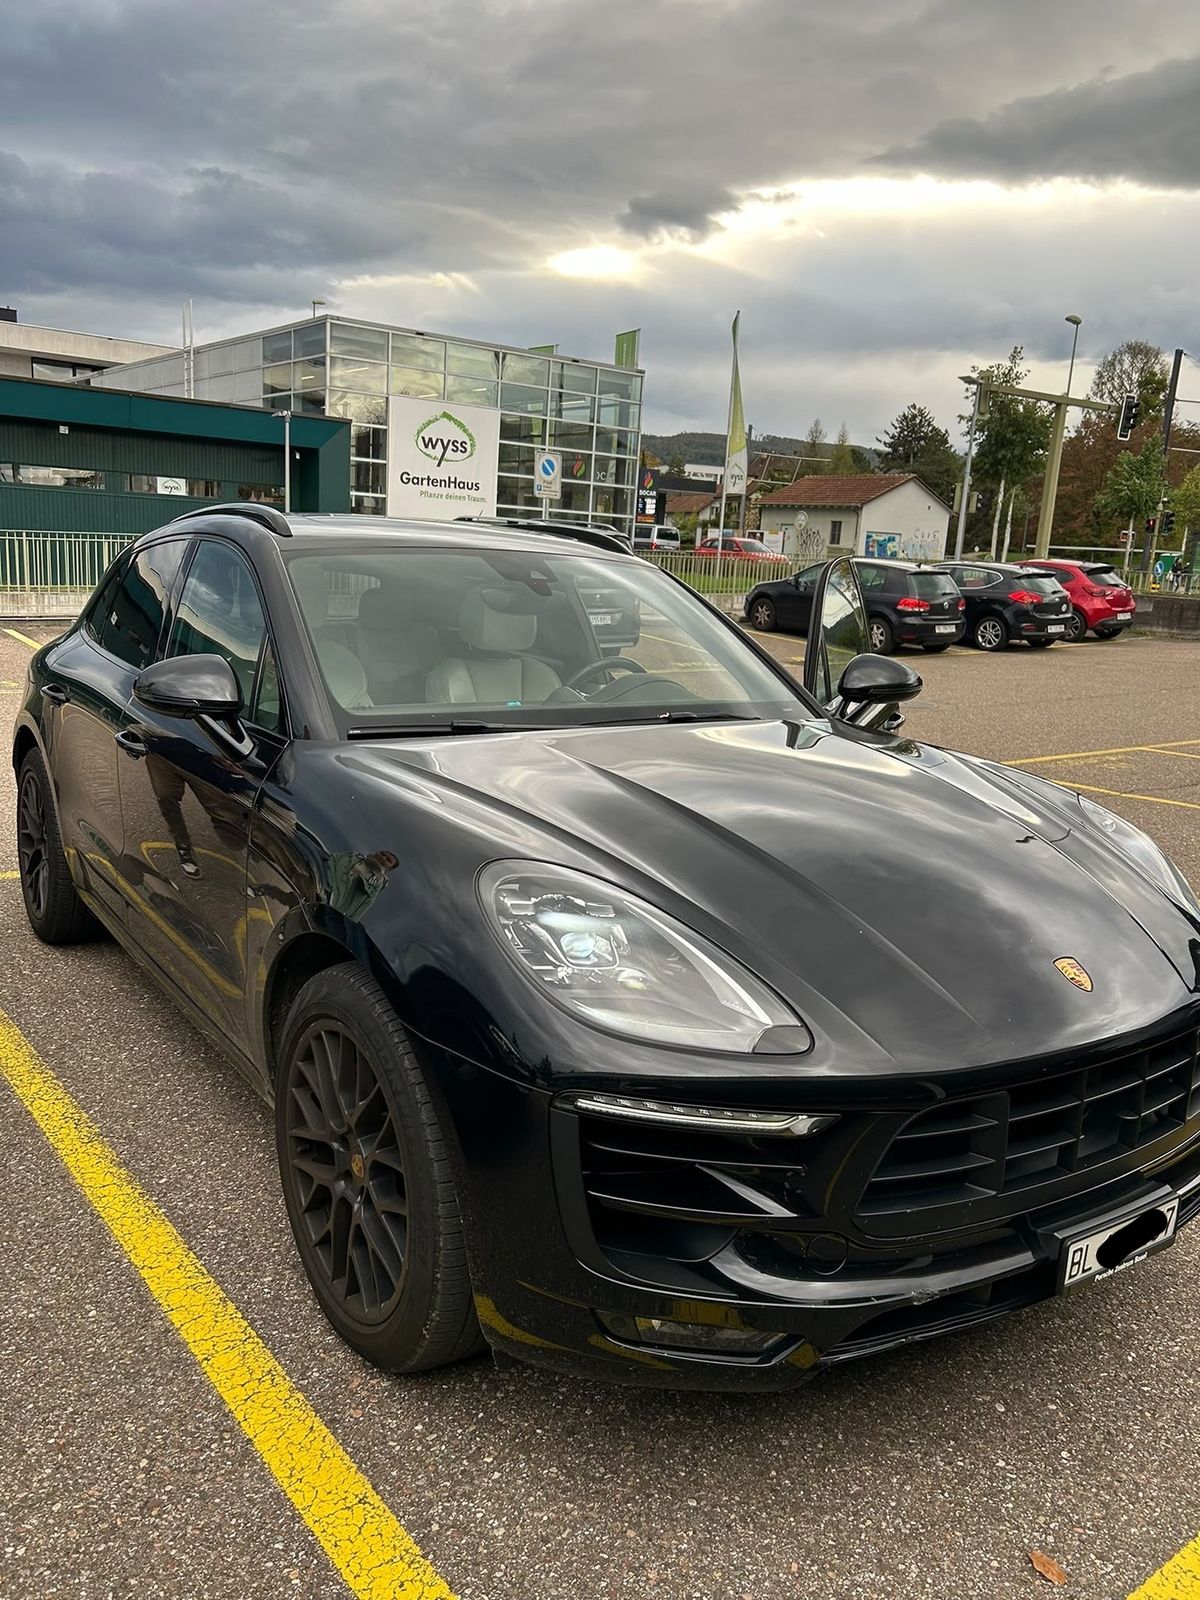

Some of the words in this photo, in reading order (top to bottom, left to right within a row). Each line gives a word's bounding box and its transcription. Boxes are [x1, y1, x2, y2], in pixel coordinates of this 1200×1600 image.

[421, 436, 468, 467] wyss
[163, 485, 179, 494] wyss
[400, 472, 480, 491] GartenHaus
[420, 490, 444, 499] Pflanze
[445, 493, 466, 501] deinen
[1068, 1244, 1092, 1280] BL
